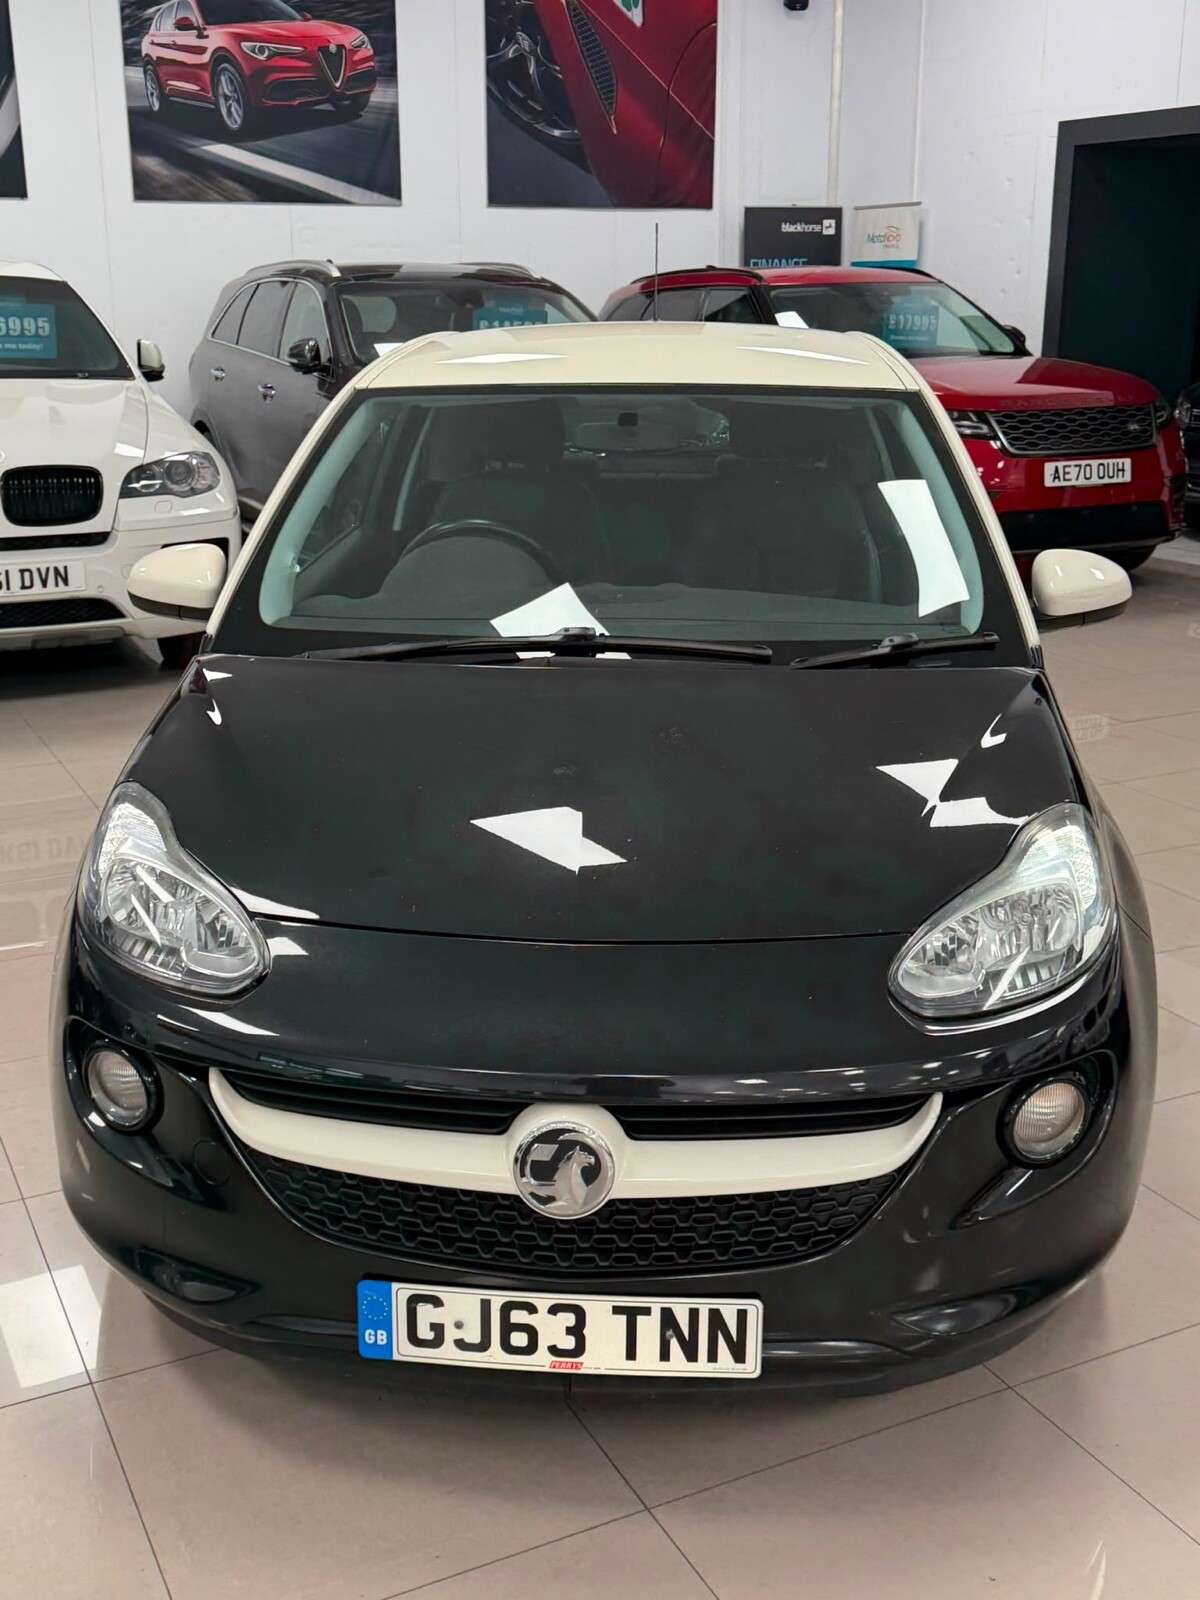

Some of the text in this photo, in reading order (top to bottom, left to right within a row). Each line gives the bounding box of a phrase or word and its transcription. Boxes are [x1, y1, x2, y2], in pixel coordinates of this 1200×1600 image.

[781, 222, 822, 232] blackhorse
[1051, 461, 1126, 483] AE70 OUH
[18, 565, 69, 590] DVN
[364, 1329, 388, 1345] GB
[406, 1293, 748, 1364] GJ63 TNN
